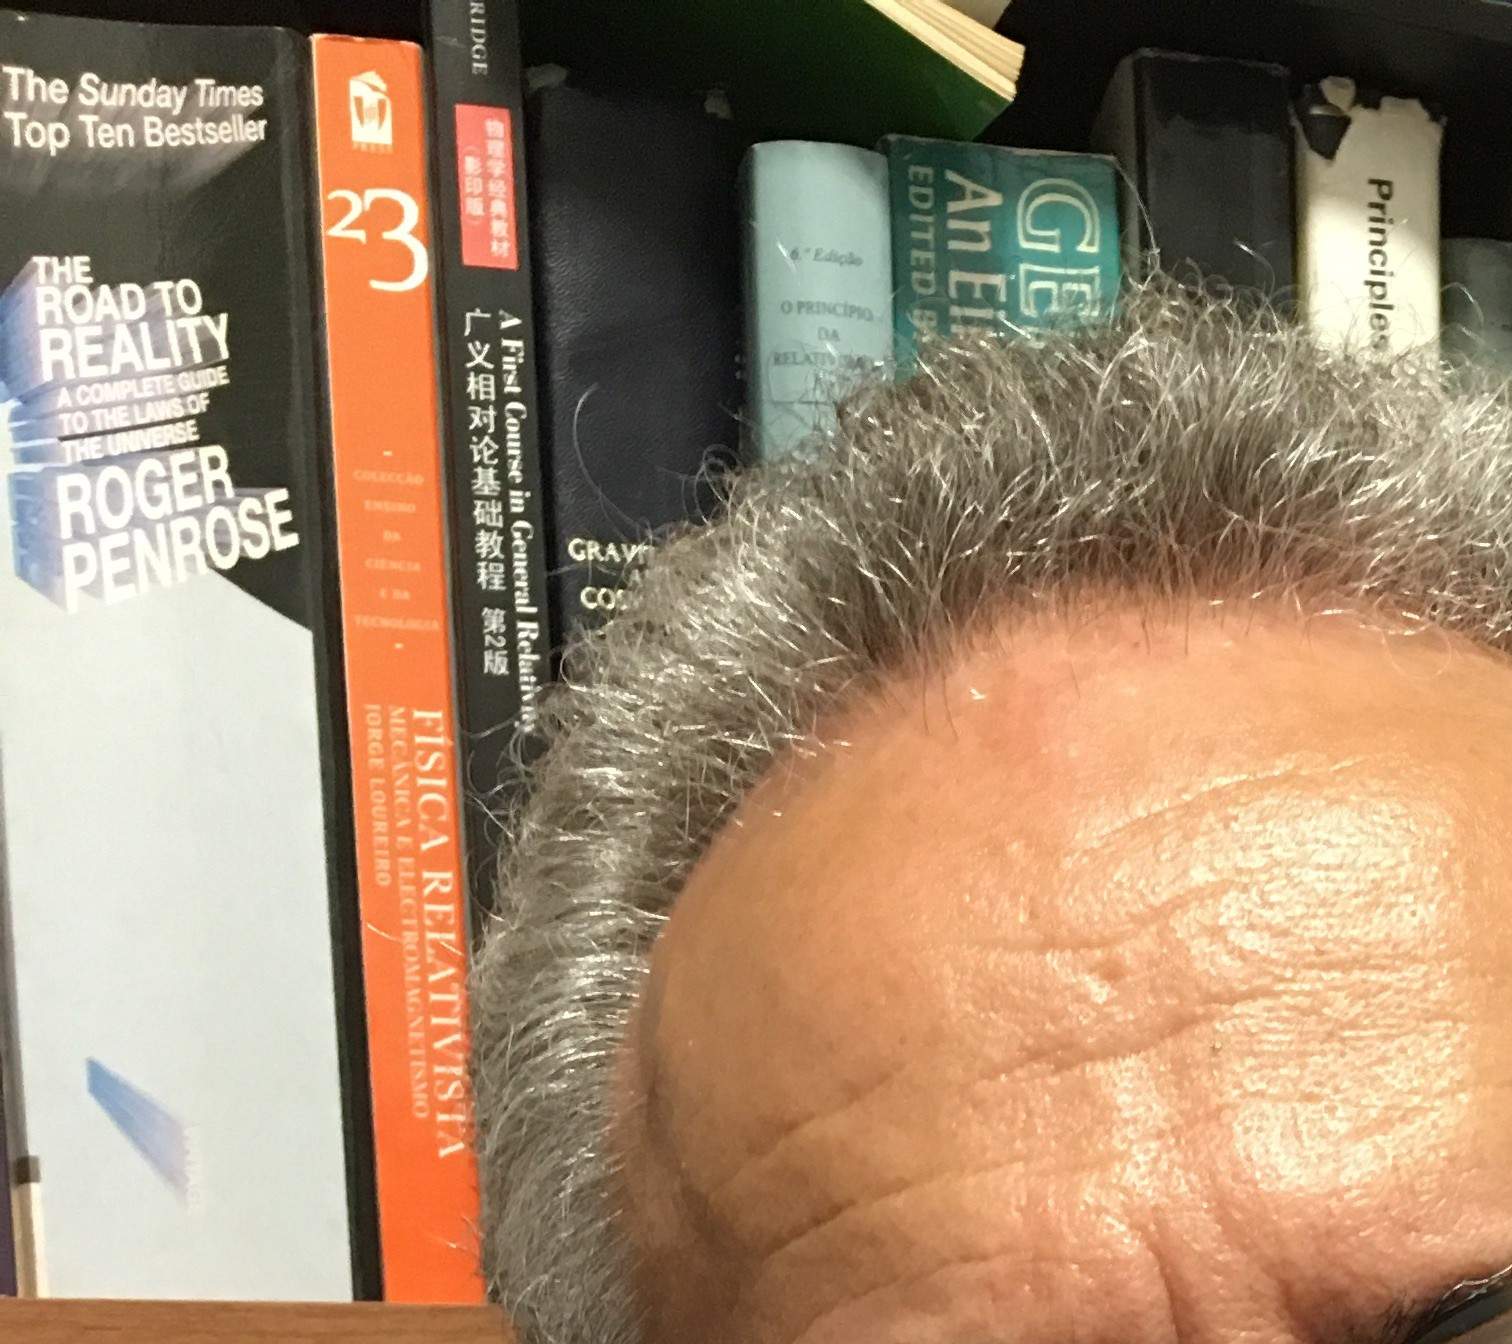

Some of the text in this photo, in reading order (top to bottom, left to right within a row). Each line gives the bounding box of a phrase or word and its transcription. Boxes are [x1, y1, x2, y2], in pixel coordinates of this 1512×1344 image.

[470, 0, 487, 76] RIDGE
[2, 66, 265, 115] The Sunday Times
[7, 112, 268, 155] Top Ten Bestseller
[326, 188, 430, 292] 23
[908, 165, 937, 296] EDITED
[945, 168, 1004, 252] An
[34, 255, 92, 286] THE
[36, 278, 203, 326] ROAD TO
[39, 313, 230, 382] REALITY
[499, 309, 522, 329] A
[58, 366, 230, 406] A COMPLETE GUIDE
[500, 334, 527, 393] First
[58, 396, 211, 432] TO THE LAWS OF
[61, 421, 200, 463] THE UNIVERSE
[463, 307, 506, 591] 广义相对论基础教程
[503, 402, 529, 484] Course
[57, 445, 234, 540] ROGER
[507, 490, 532, 515] in
[63, 489, 300, 612] PENROSE
[509, 519, 540, 612] General
[362, 704, 393, 888] JORGE LOUREIRO
[421, 870, 467, 1158] RELATIVISTA
